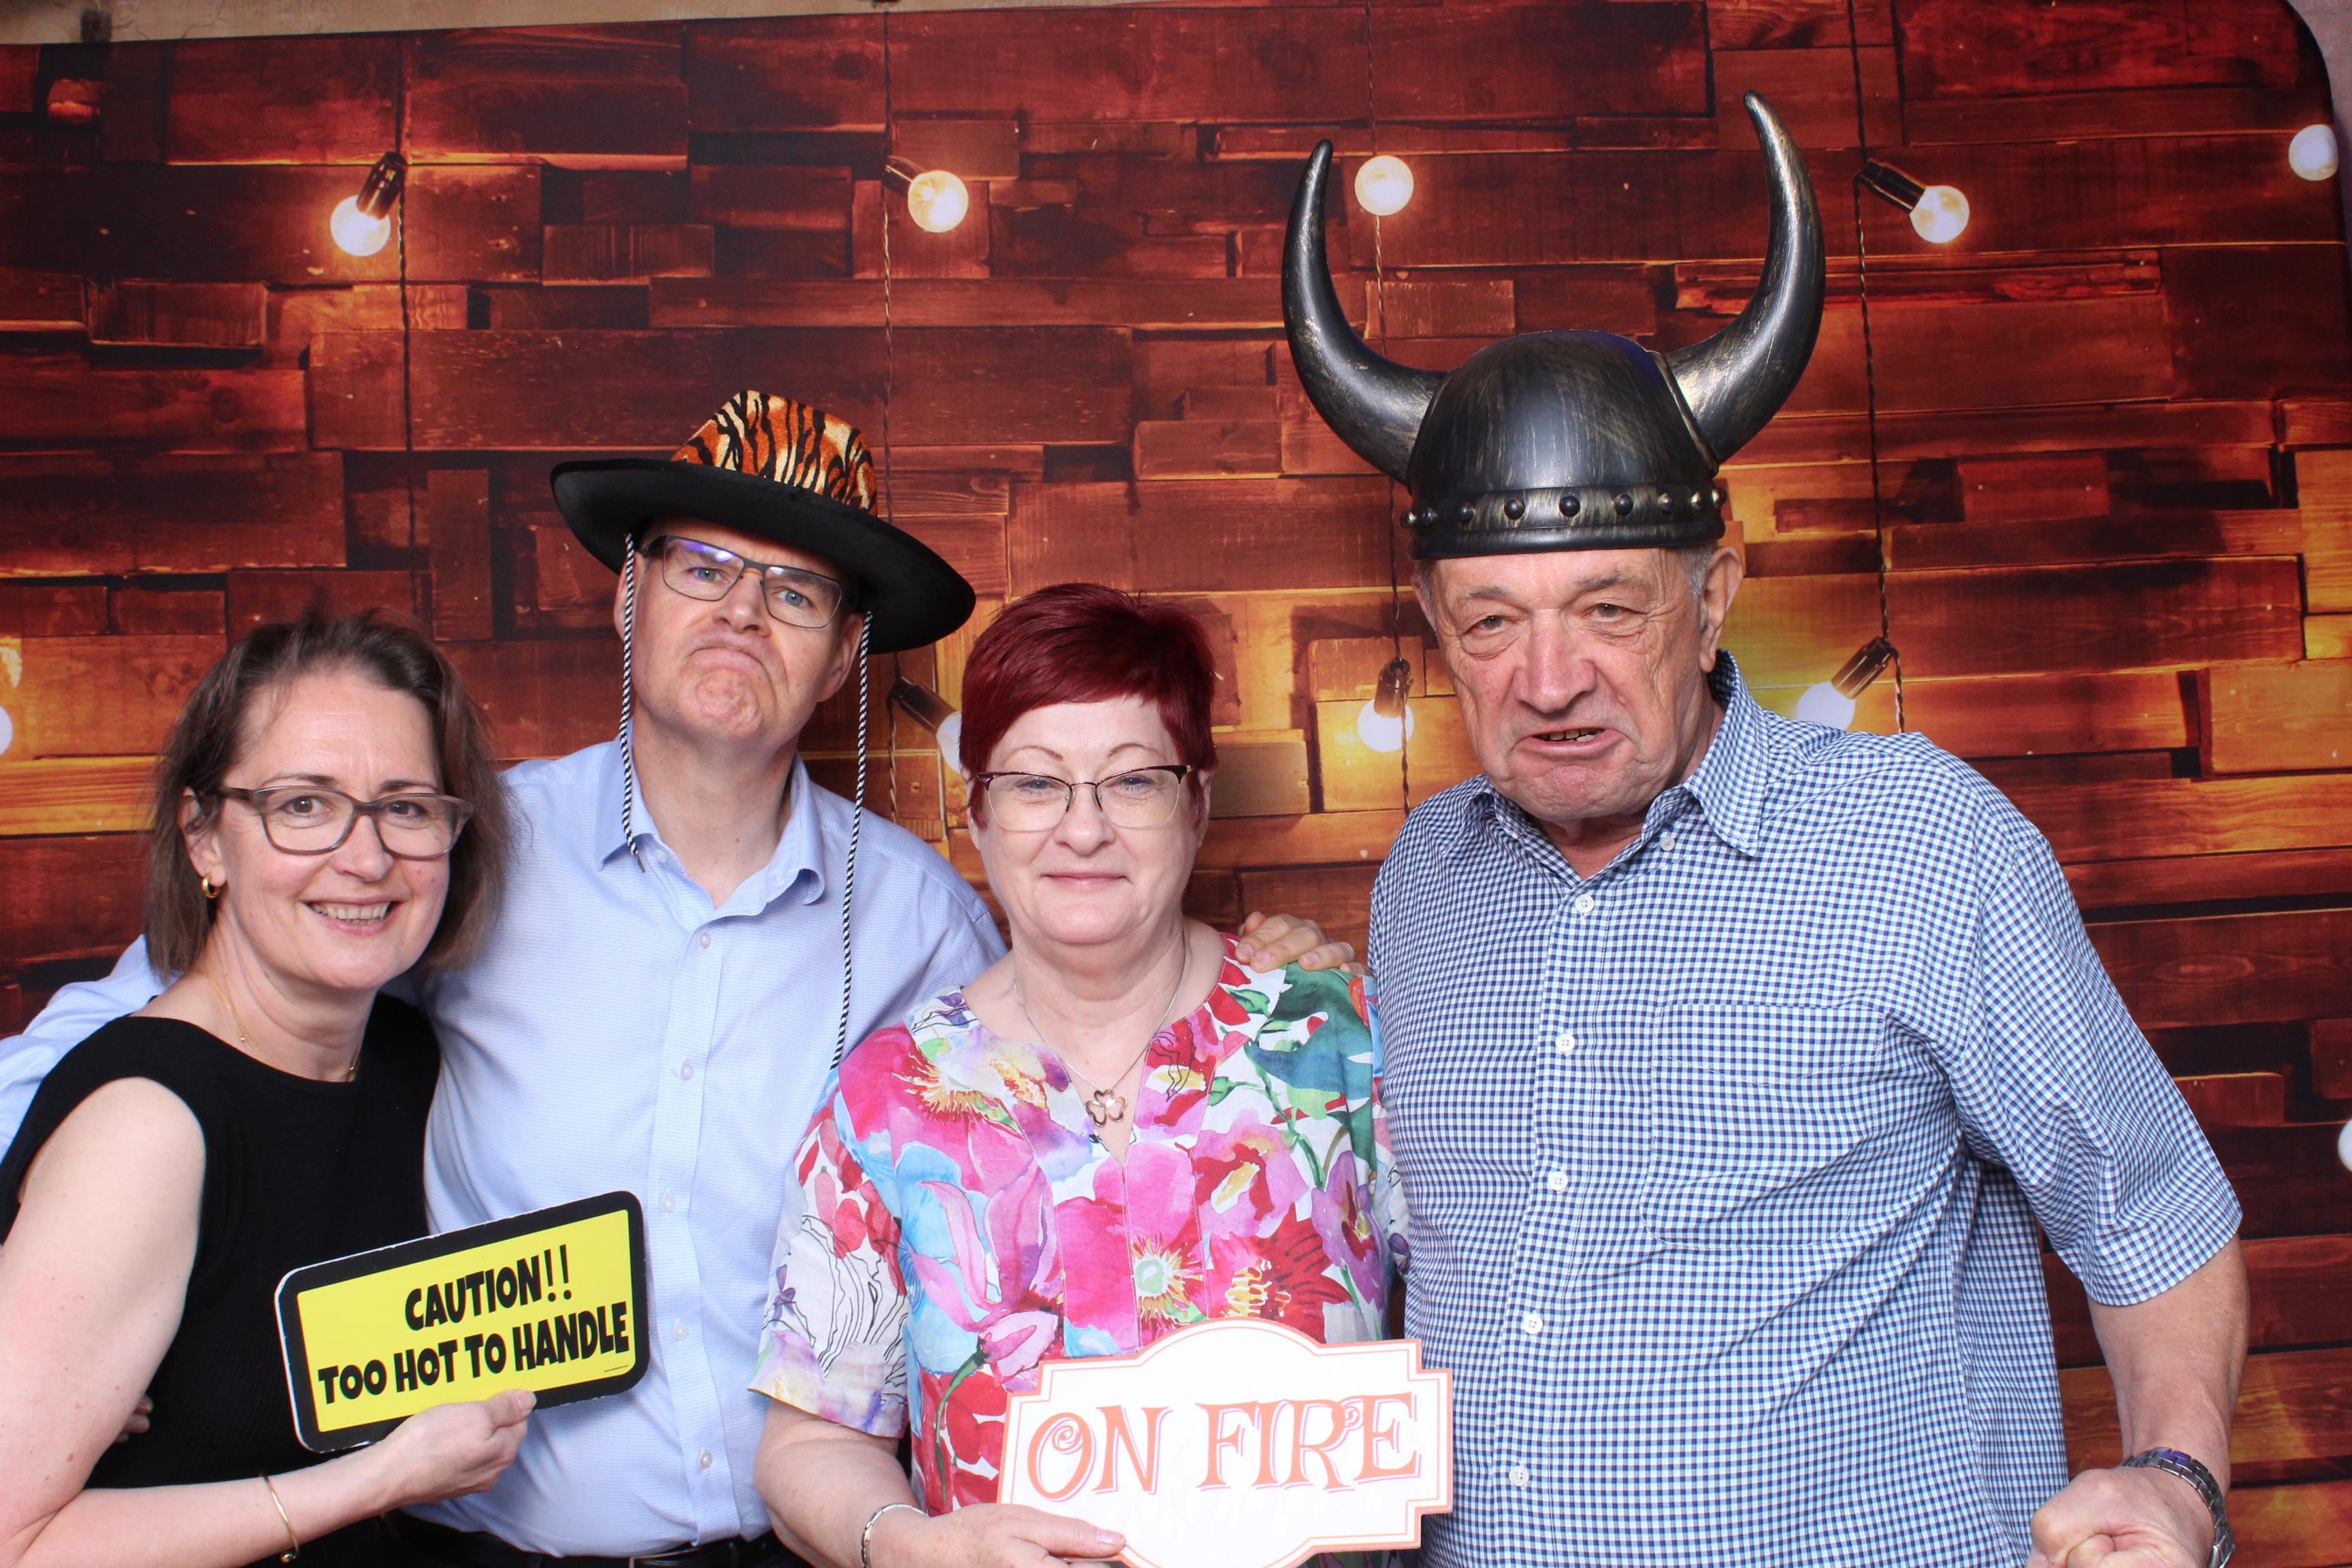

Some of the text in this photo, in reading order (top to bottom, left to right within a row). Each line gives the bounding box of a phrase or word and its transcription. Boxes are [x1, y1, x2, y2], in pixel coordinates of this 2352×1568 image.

[405, 1244, 572, 1331] CAUTION!!
[318, 1301, 630, 1404] TOO HOT TO HANDLE
[1027, 1391, 1422, 1501] ON FIRE
